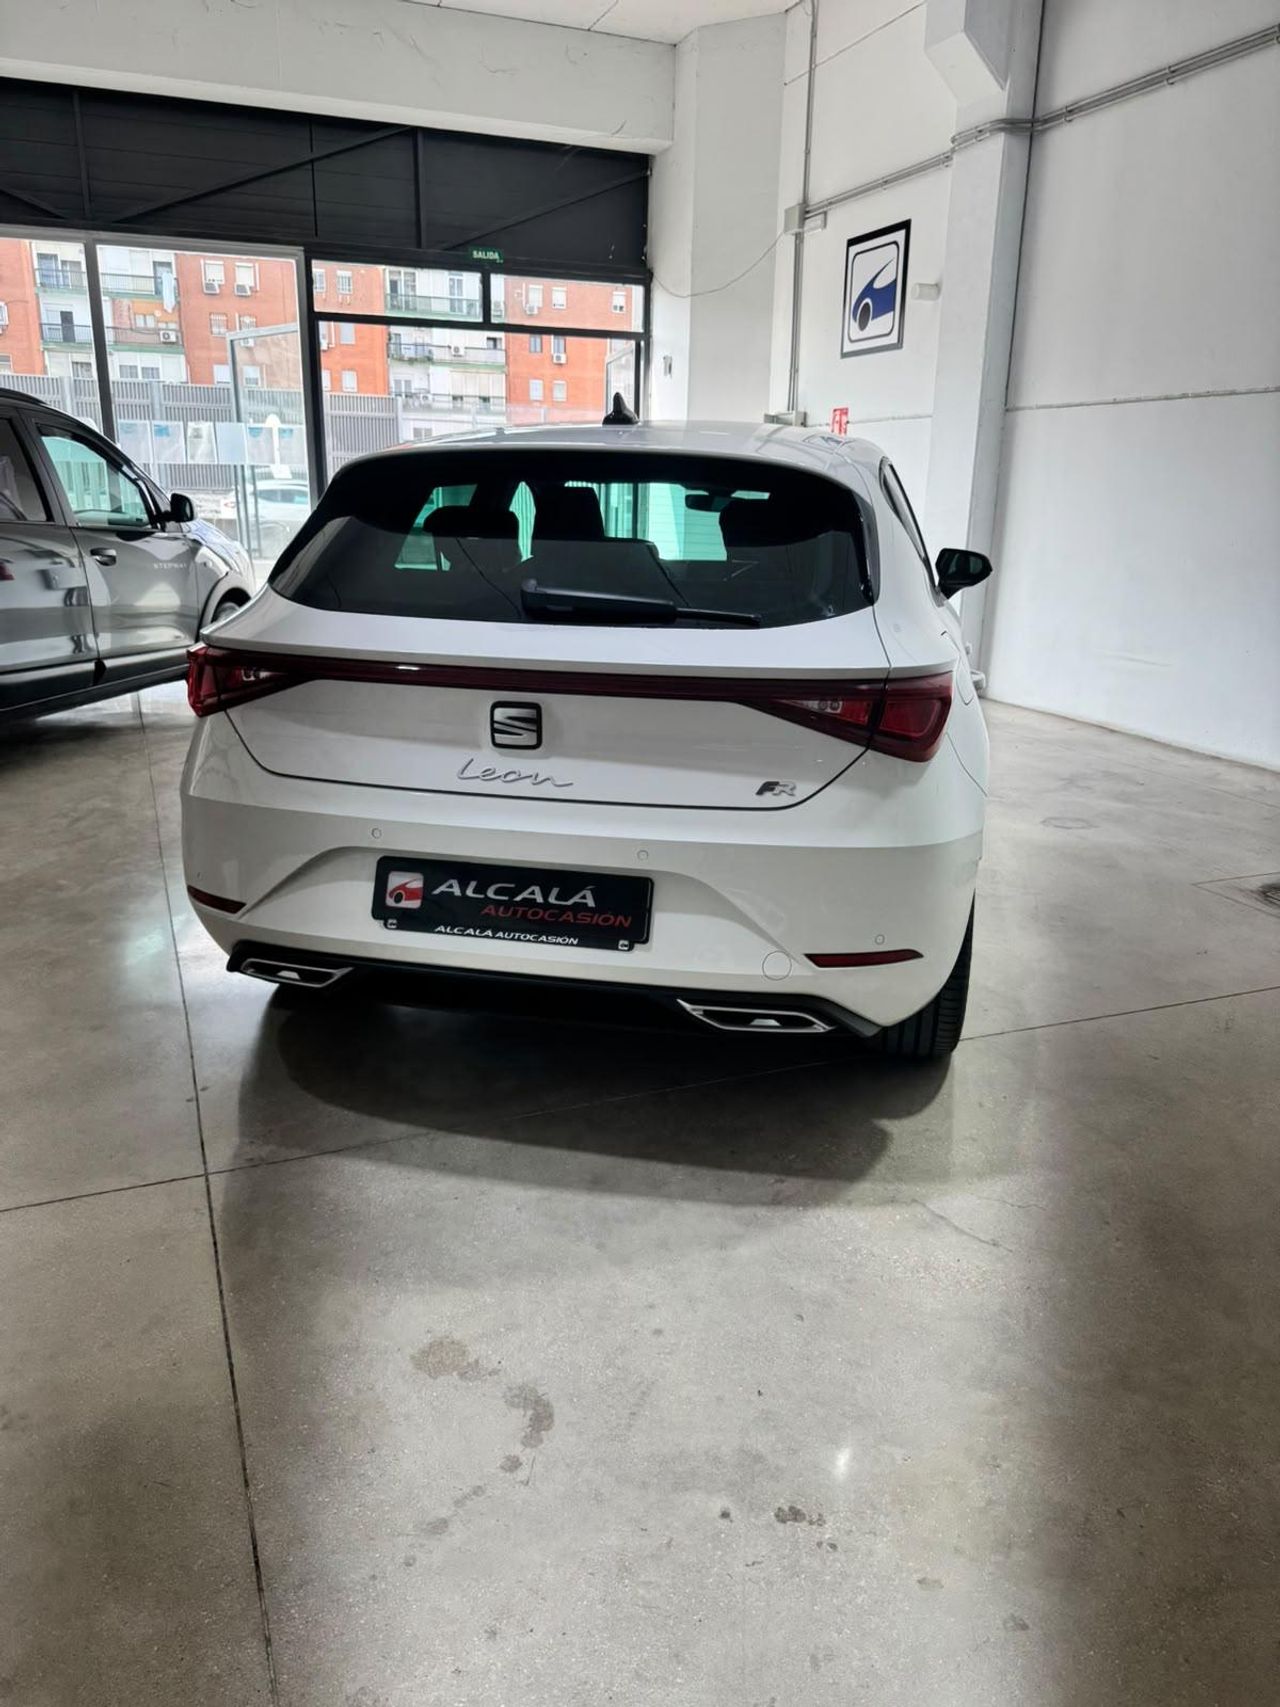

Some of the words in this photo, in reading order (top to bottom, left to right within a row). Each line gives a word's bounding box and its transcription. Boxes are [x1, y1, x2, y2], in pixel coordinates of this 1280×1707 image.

[472, 250, 499, 259] SALIDA
[456, 758, 574, 788] Leon
[755, 780, 797, 797] FR
[431, 878, 597, 908] ALCALÁ
[479, 904, 633, 928] AUTOCASIÓN
[494, 930, 579, 946] AUTOCASIÓN
